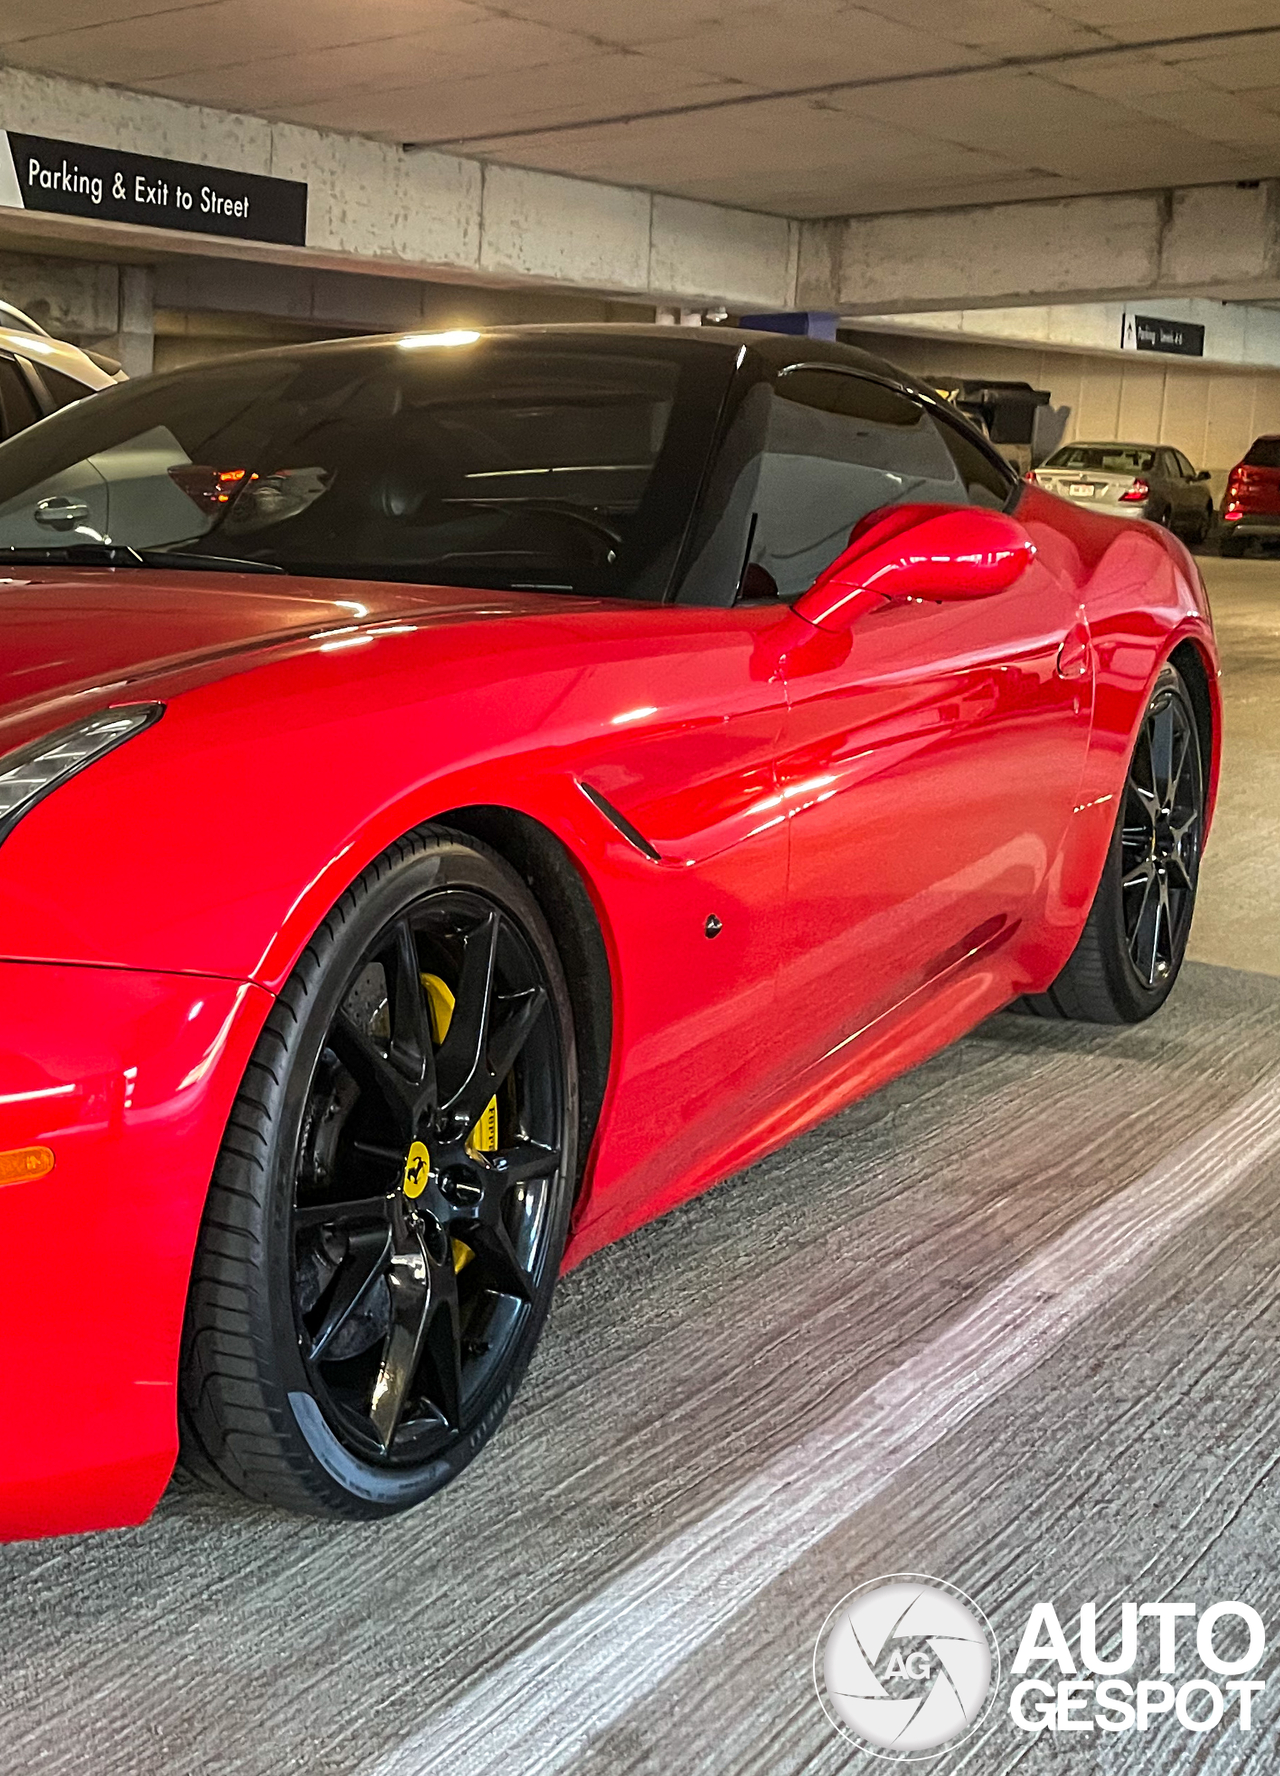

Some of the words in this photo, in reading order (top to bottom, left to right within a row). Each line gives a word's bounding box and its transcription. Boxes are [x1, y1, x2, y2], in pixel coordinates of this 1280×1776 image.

[28, 157, 103, 204] Parking
[112, 172, 126, 200] &
[135, 176, 169, 206] Exit
[176, 186, 193, 210] to
[200, 186, 249, 218] Street
